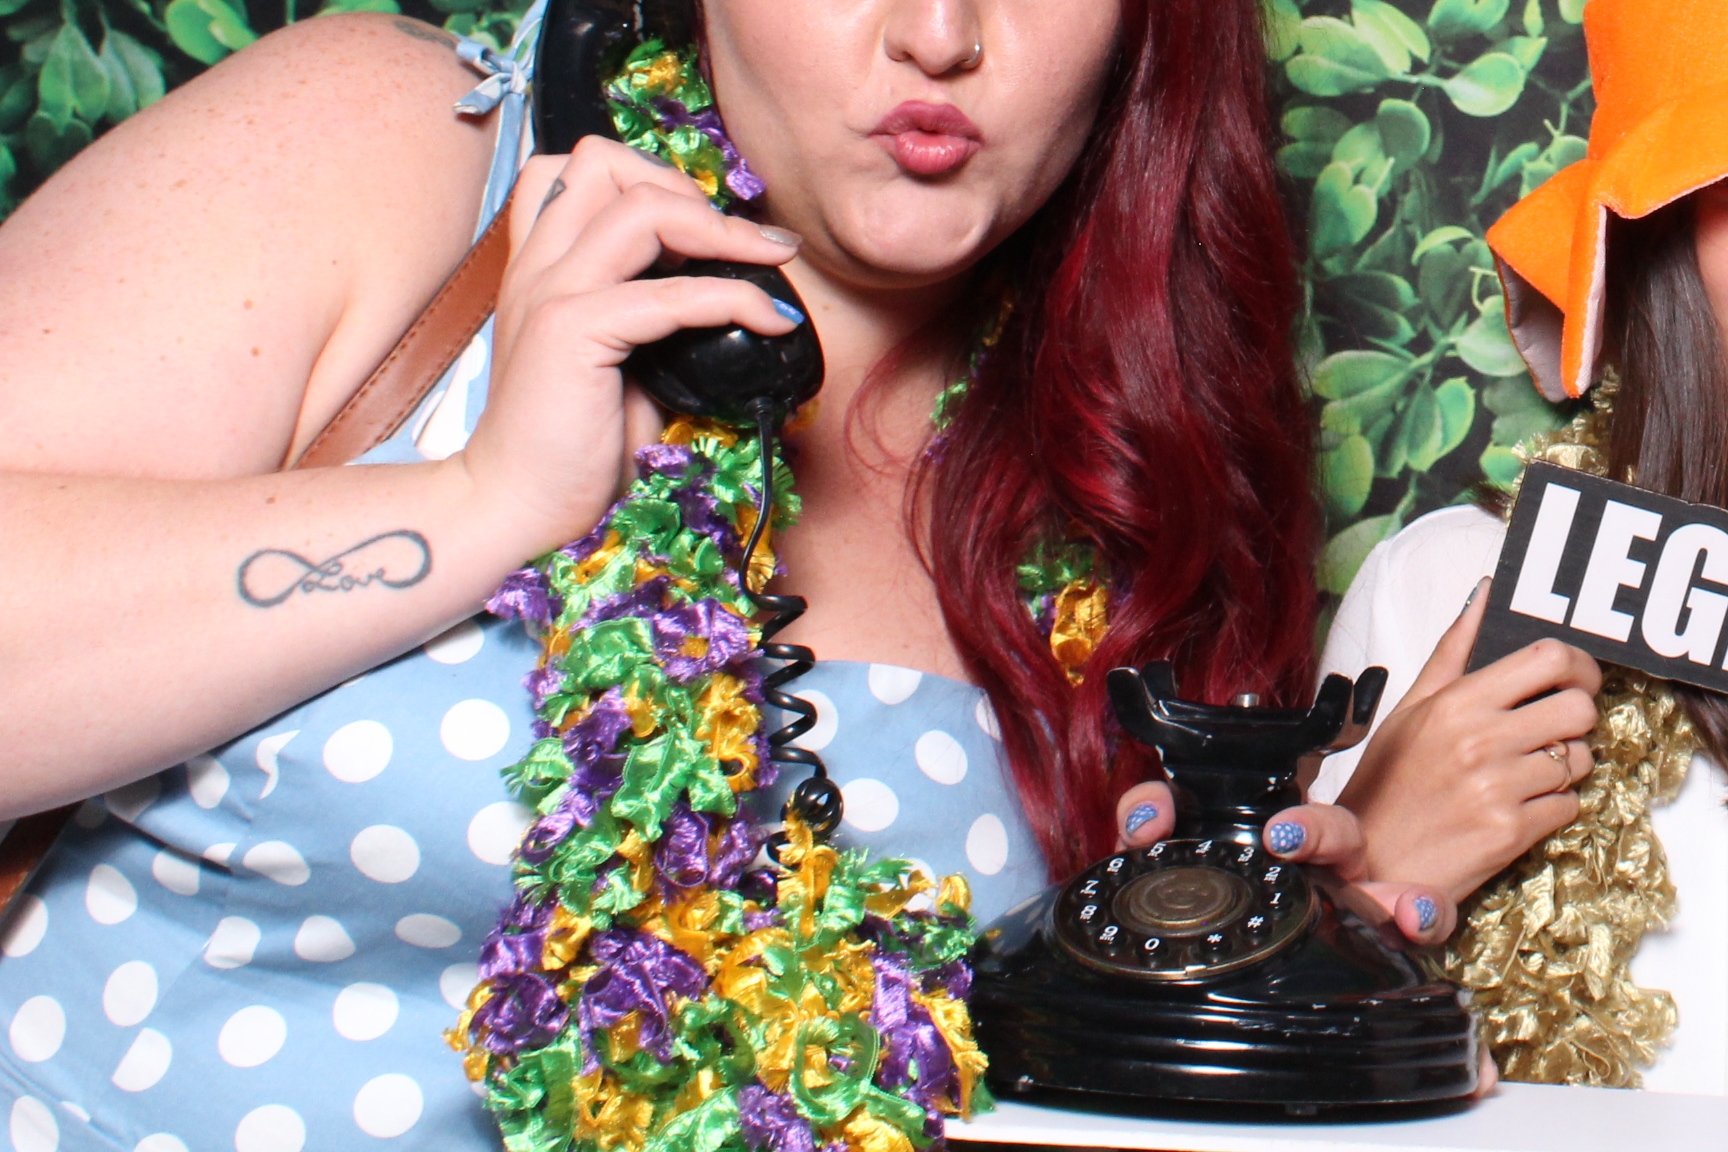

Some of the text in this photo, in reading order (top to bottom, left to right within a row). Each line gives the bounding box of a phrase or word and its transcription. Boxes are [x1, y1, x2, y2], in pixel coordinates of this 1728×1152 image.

[302, 559, 386, 594] Love
[1109, 858, 1125, 869] 6
[1266, 866, 1281, 877] 2
[1085, 880, 1099, 891] 7
[1270, 892, 1281, 905] 1
[1081, 905, 1097, 917] 8
[1103, 926, 1118, 938] 9
